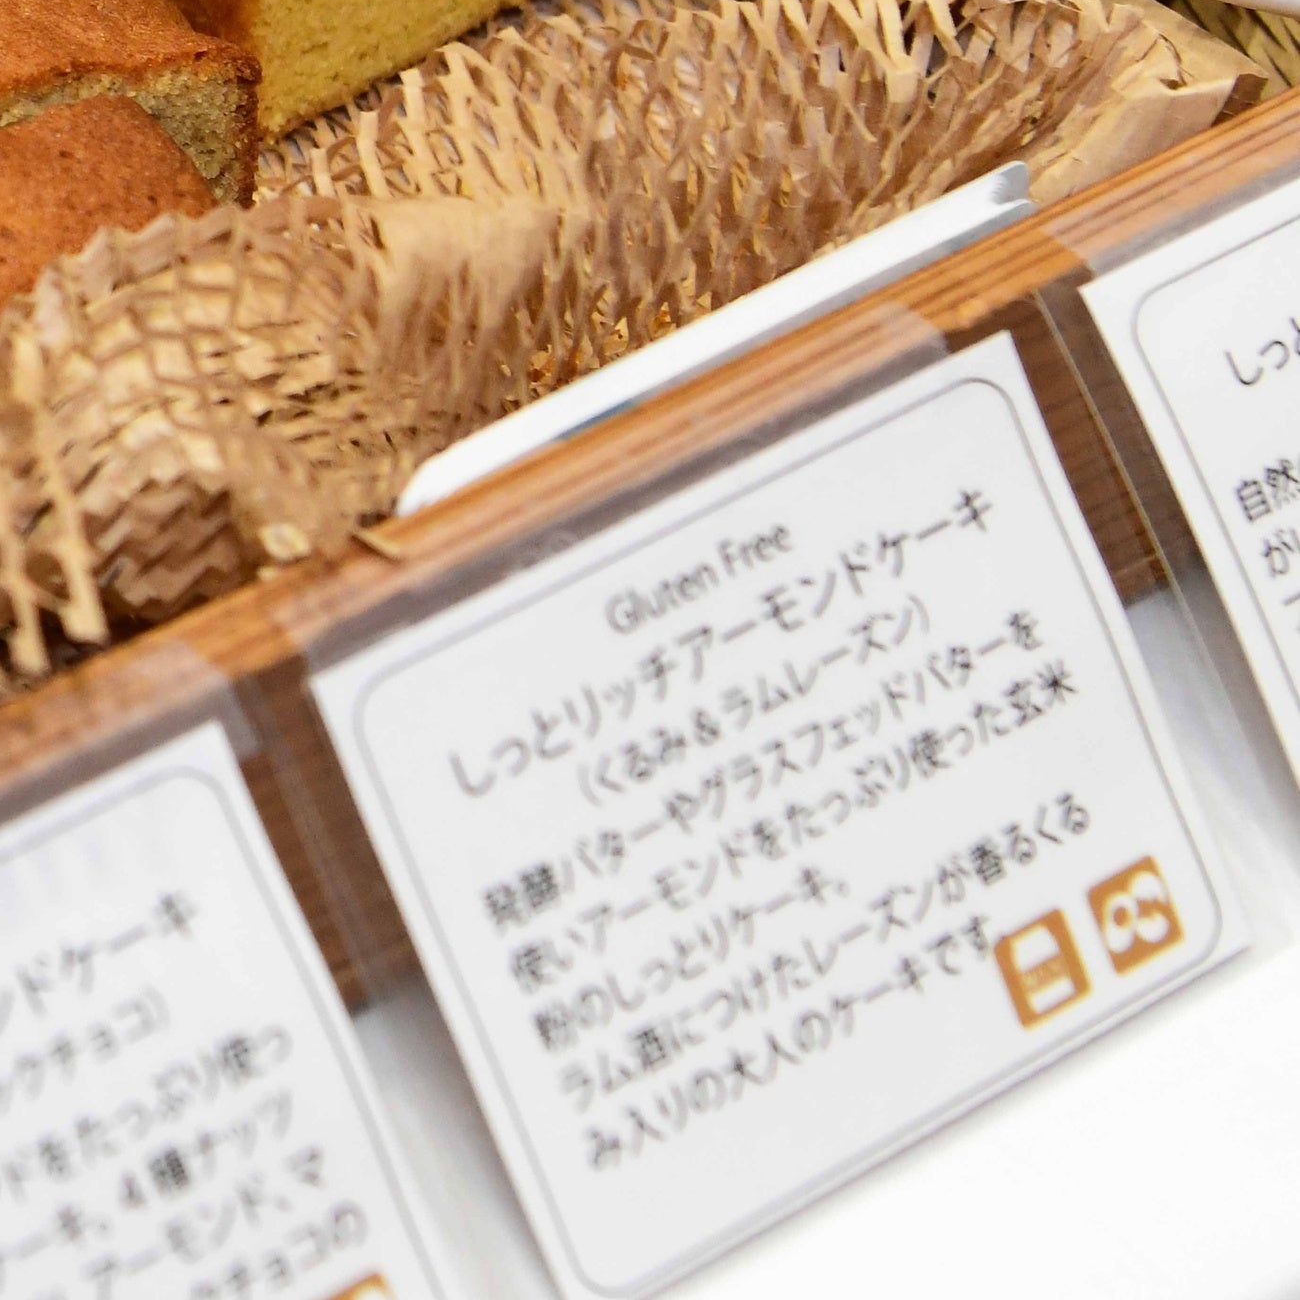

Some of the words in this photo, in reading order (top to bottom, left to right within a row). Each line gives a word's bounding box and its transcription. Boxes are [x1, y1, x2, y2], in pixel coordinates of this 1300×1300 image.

[1225, 317, 1300, 386] しっ
[604, 561, 720, 634] Gluten
[718, 525, 794, 578] Free
[560, 794, 1090, 1114] ラム酒につけたレーズンが香るくる
